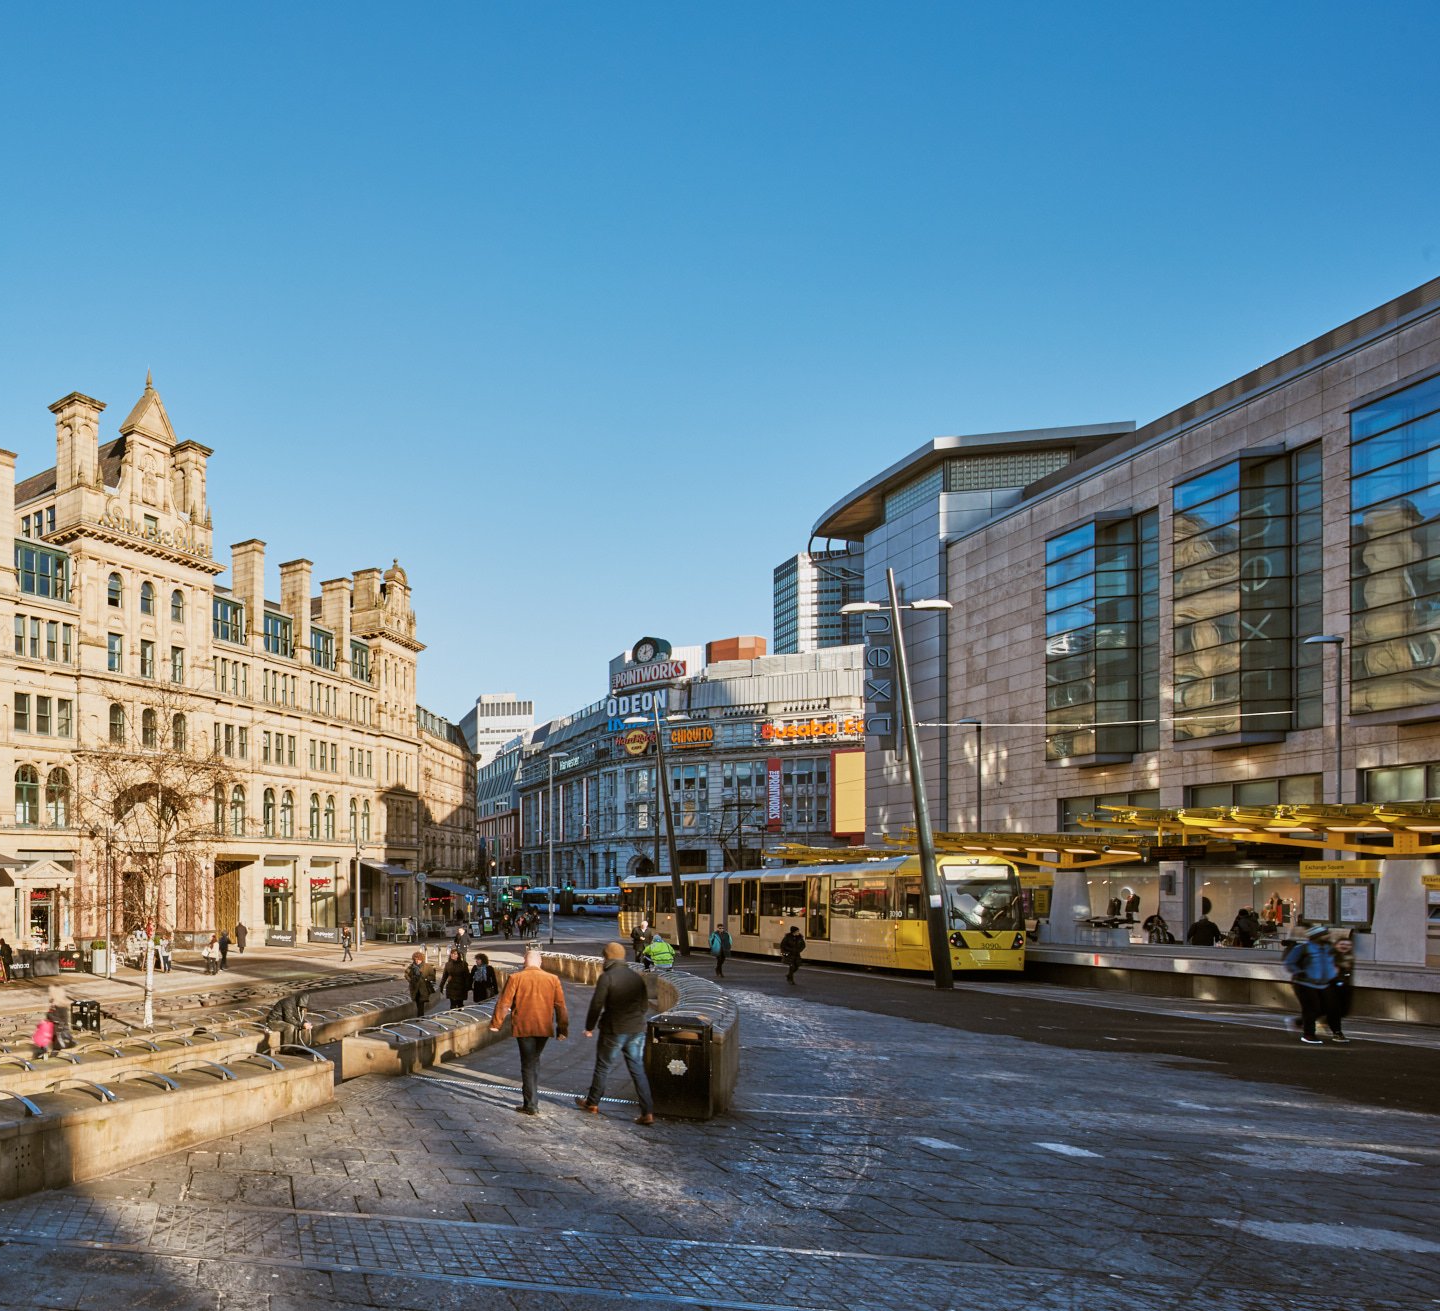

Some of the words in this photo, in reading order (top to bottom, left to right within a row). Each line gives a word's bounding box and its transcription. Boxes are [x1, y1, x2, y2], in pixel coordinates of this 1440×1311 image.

[616, 661, 684, 688] PRINTWORKS
[867, 614, 892, 731] next
[607, 688, 666, 717] ODEON
[671, 727, 713, 743] CHIQUITO
[761, 719, 837, 739] Busaba
[769, 775, 780, 819] PRINTWORKS
